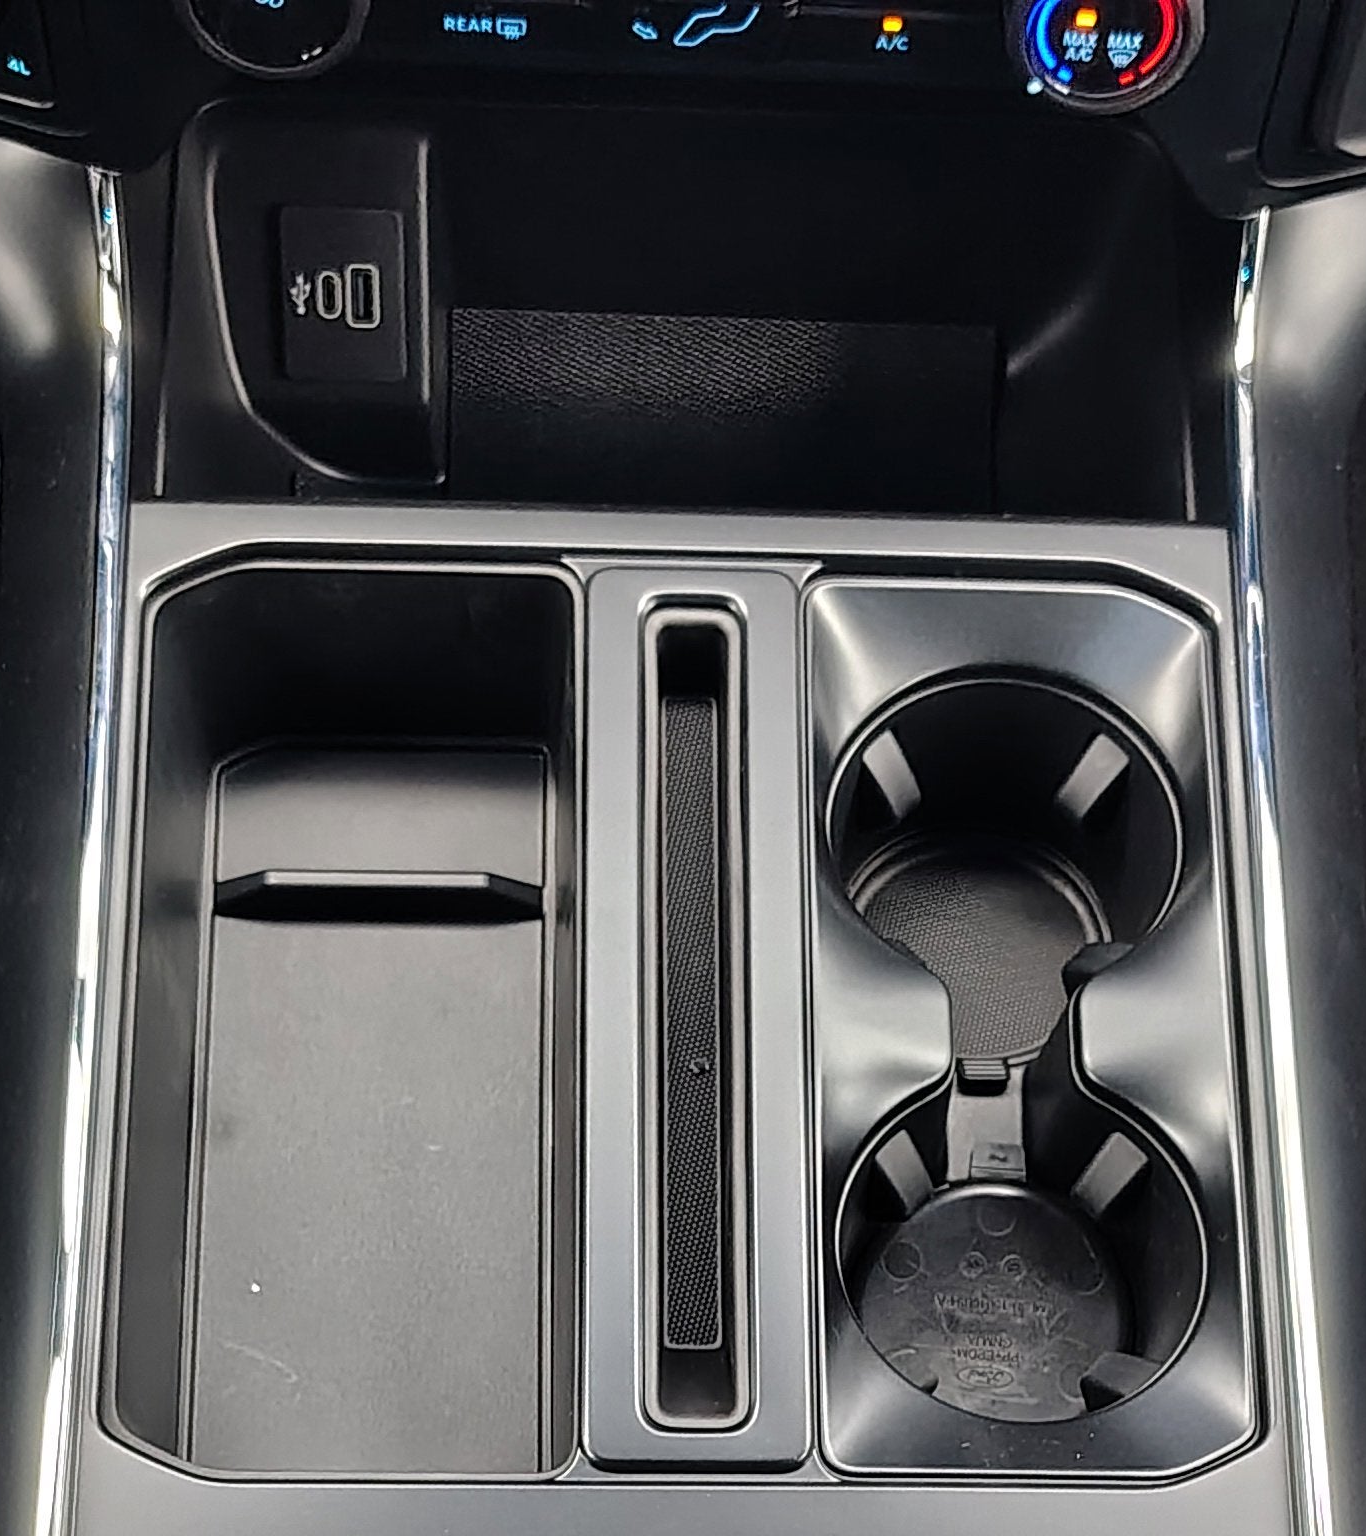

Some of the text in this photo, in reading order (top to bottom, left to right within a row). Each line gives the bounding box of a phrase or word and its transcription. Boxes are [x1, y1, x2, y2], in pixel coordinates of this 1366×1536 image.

[442, 12, 492, 34] REAR
[875, 34, 910, 51] A/C
[1063, 28, 1100, 48] MAX
[1107, 28, 1144, 49] MAX
[5, 53, 32, 77] 4L
[1064, 48, 1094, 63] A/C
